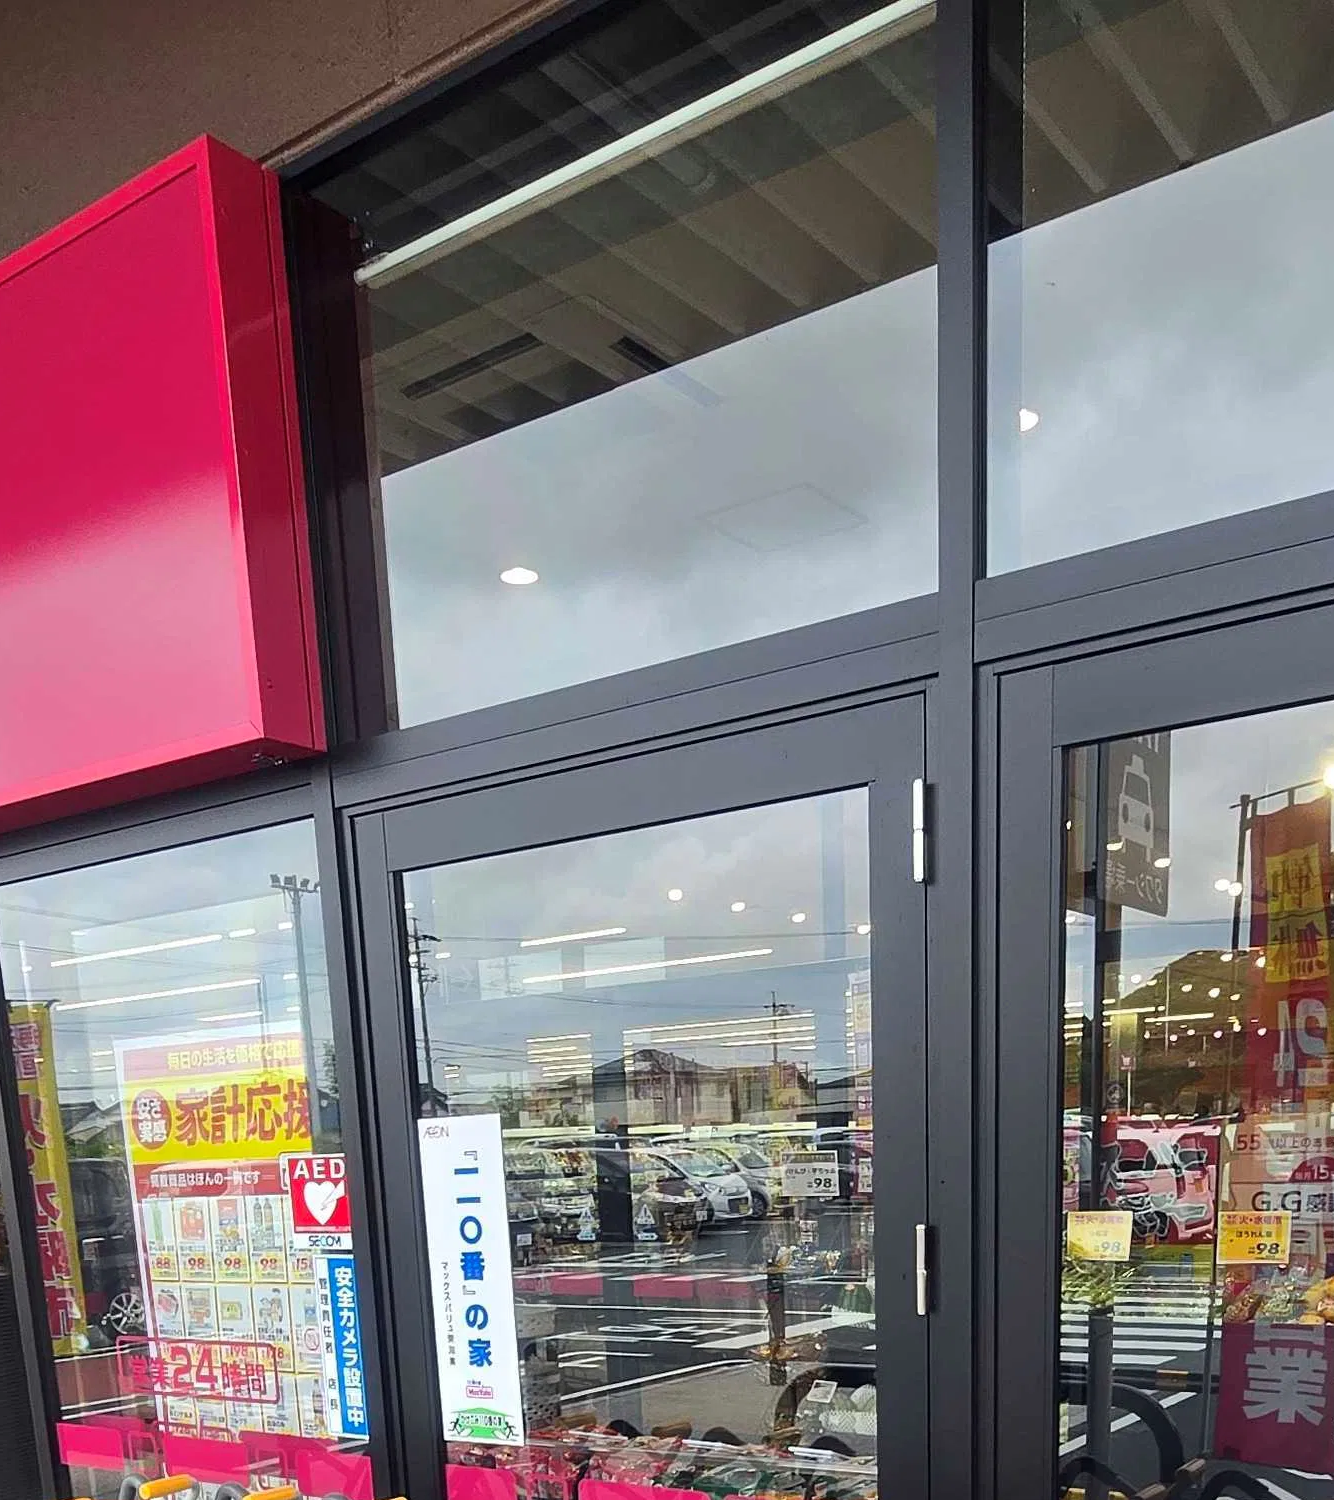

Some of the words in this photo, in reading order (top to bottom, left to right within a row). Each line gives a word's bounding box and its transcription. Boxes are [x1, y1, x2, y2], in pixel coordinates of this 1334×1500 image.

[292, 1157, 346, 1180] AED
[309, 1235, 342, 1248] SECOM
[1256, 1242, 1281, 1255] 98
[334, 1265, 366, 1428] 安全カメラ設置中
